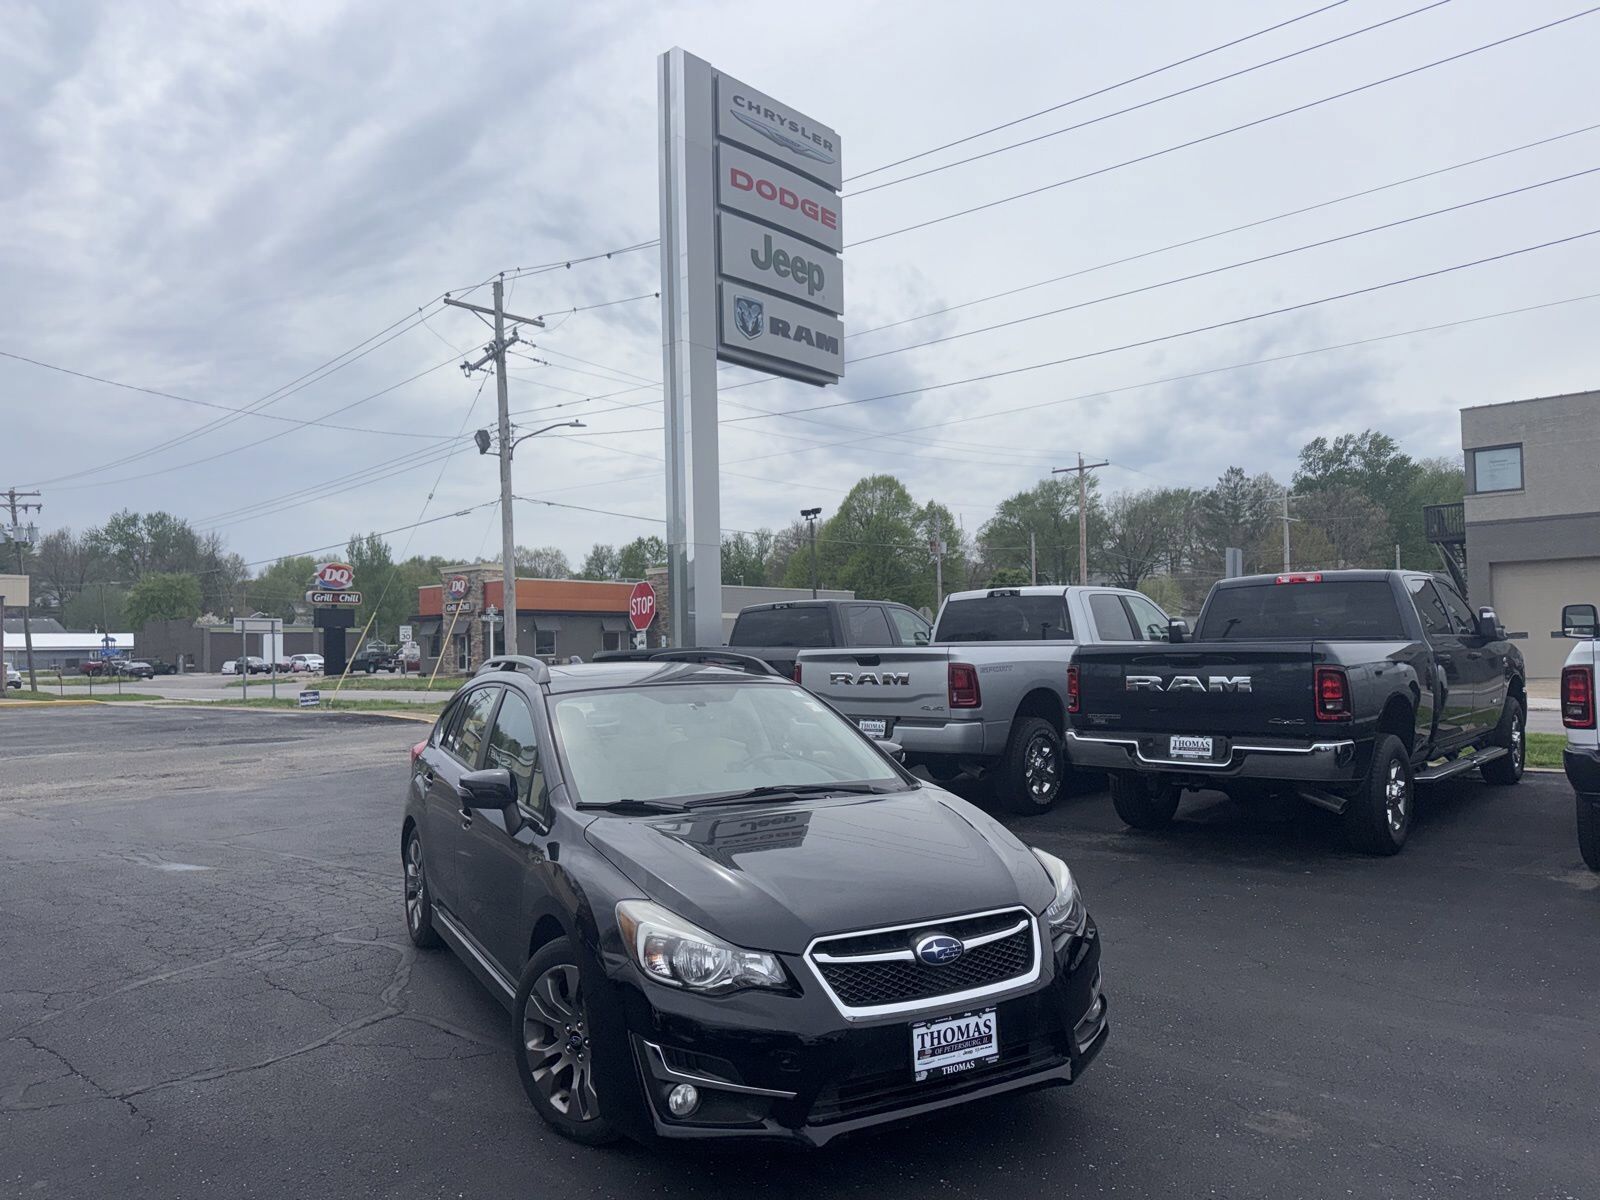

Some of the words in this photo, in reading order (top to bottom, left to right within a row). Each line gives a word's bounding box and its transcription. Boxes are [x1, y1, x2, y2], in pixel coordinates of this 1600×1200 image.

[732, 95, 833, 152] CHRYSLER
[730, 167, 837, 230] DODGE
[750, 233, 825, 296] Jeep
[769, 316, 839, 355] RAM
[323, 568, 349, 584] DQ
[451, 580, 466, 593] DQ
[313, 593, 333, 602] Grill
[339, 594, 359, 602] Chill
[631, 596, 654, 616] STOP
[829, 672, 910, 686] RAM
[1125, 675, 1253, 693] RAM
[1173, 739, 1210, 748] THOMAS
[917, 1019, 992, 1050] THOMAS
[941, 1060, 975, 1074] THOMAS
